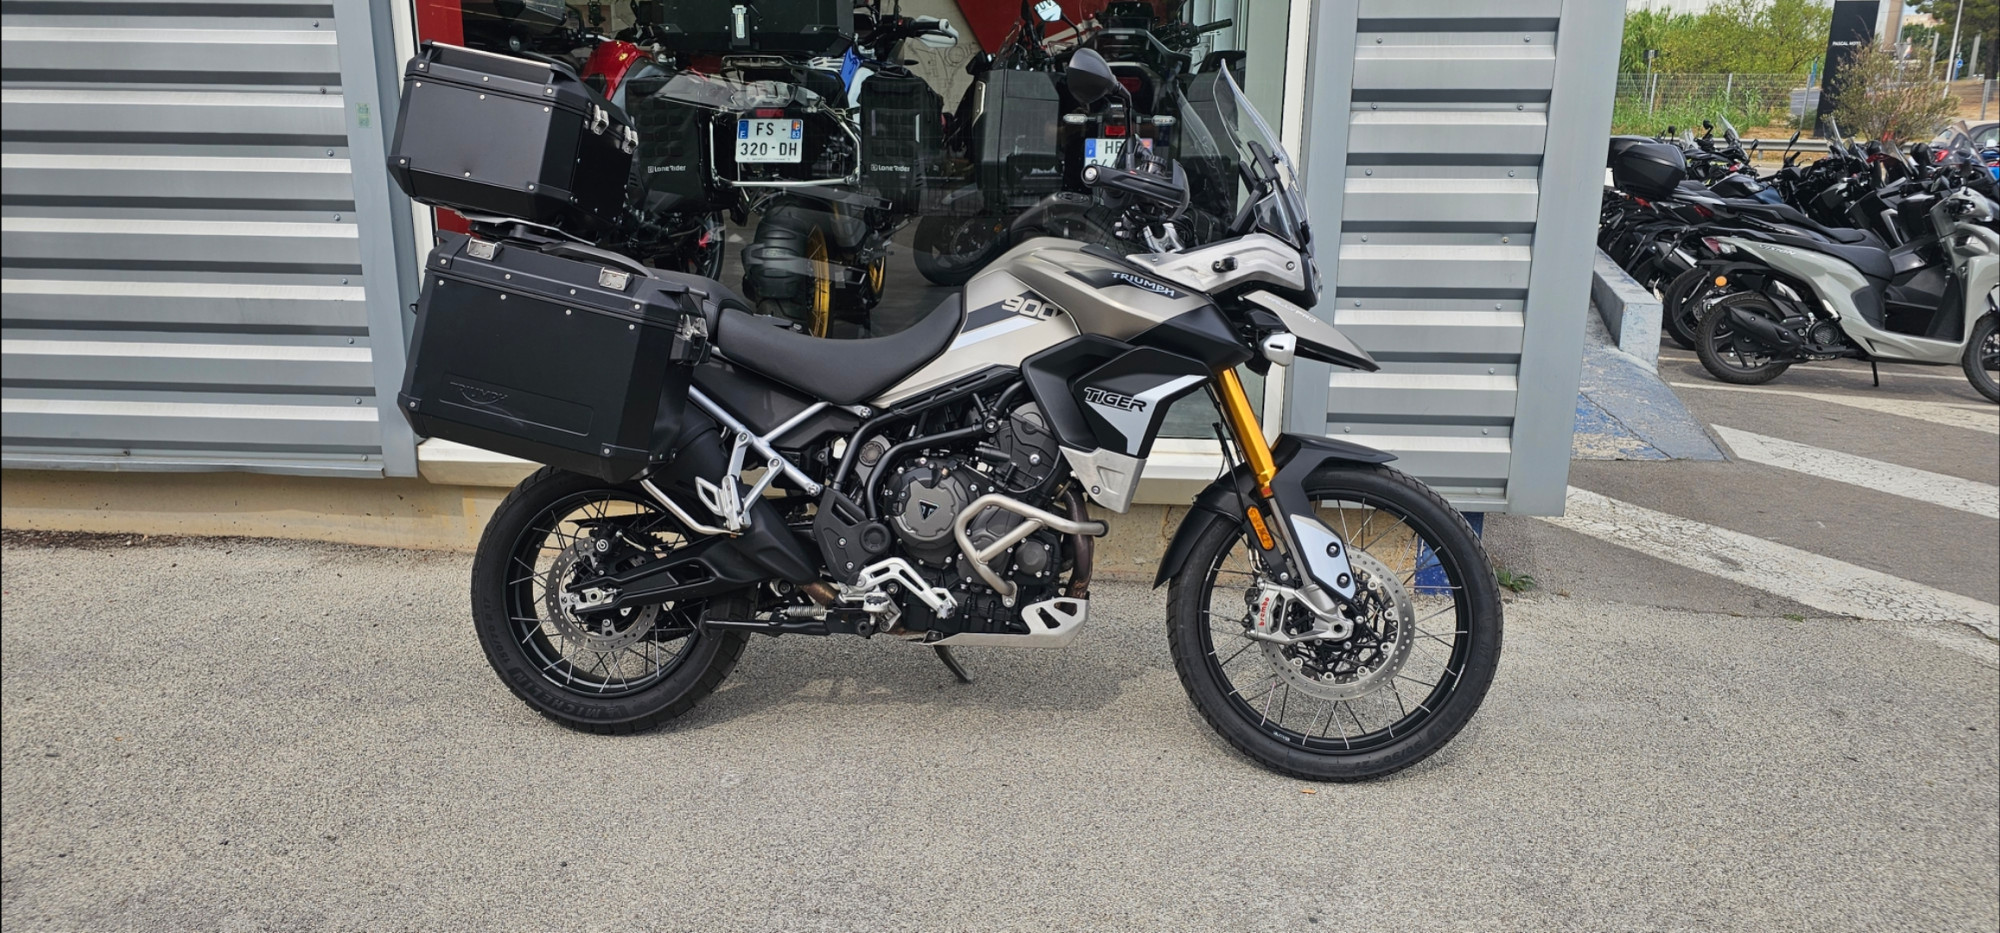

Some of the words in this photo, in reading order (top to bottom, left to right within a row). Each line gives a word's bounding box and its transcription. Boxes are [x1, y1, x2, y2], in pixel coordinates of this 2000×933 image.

[756, 122, 774, 136] FS
[1111, 272, 1176, 297] TRIUMPH
[1001, 296, 1057, 321] 900
[1084, 386, 1147, 412] TIGER
[1258, 597, 1270, 627] brembo
[512, 667, 601, 718] MICHELIN
